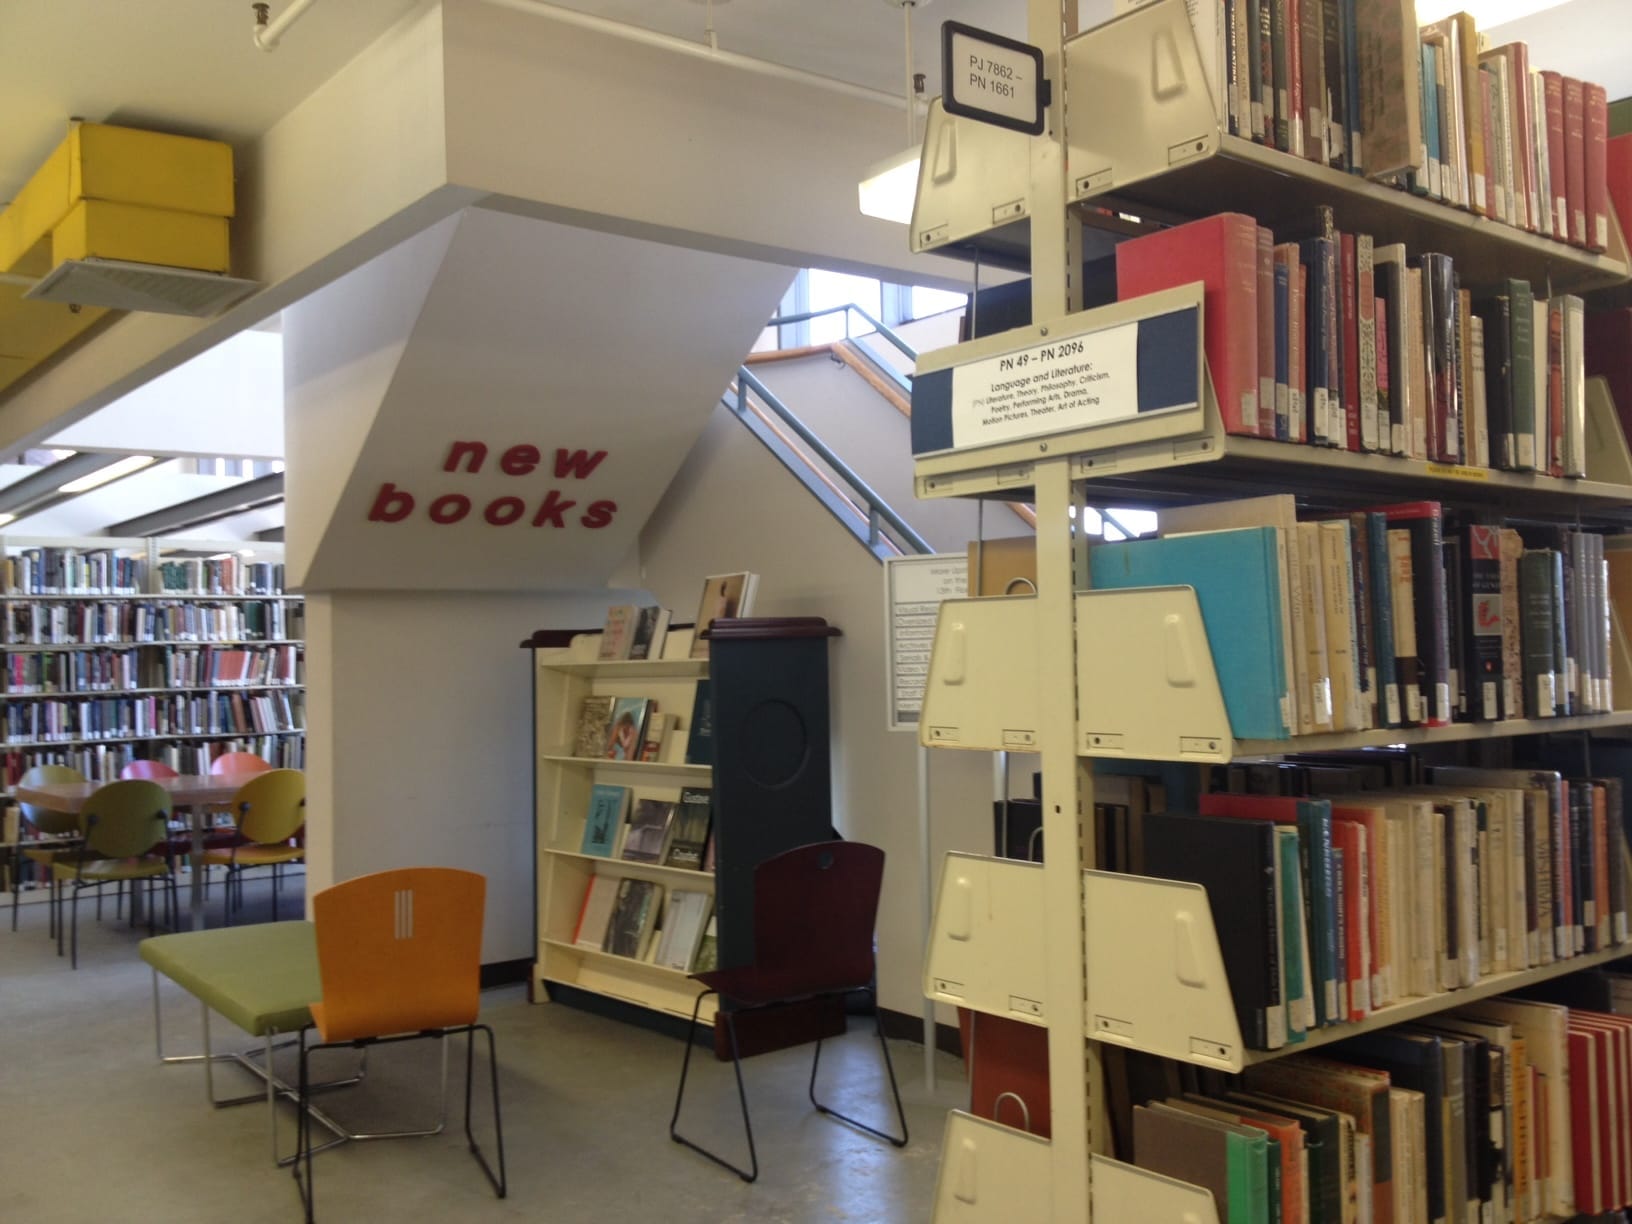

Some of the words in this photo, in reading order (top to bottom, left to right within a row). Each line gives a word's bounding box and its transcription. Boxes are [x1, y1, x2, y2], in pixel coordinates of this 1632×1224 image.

[969, 55, 984, 71] PJ
[986, 60, 1013, 80] 7862
[969, 73, 986, 90] PN
[990, 80, 1015, 98] 1661
[1000, 357, 1014, 372] PN
[1016, 353, 1029, 368] 49
[1041, 347, 1055, 362] PN
[1058, 340, 1084, 358] 2096
[991, 377, 1031, 392] Language
[1033, 370, 1049, 383] and
[1058, 402, 1068, 411] Art
[1069, 400, 1076, 409] of
[1077, 396, 1100, 408] Acting
[443, 440, 609, 480] new
[367, 482, 618, 529] books
